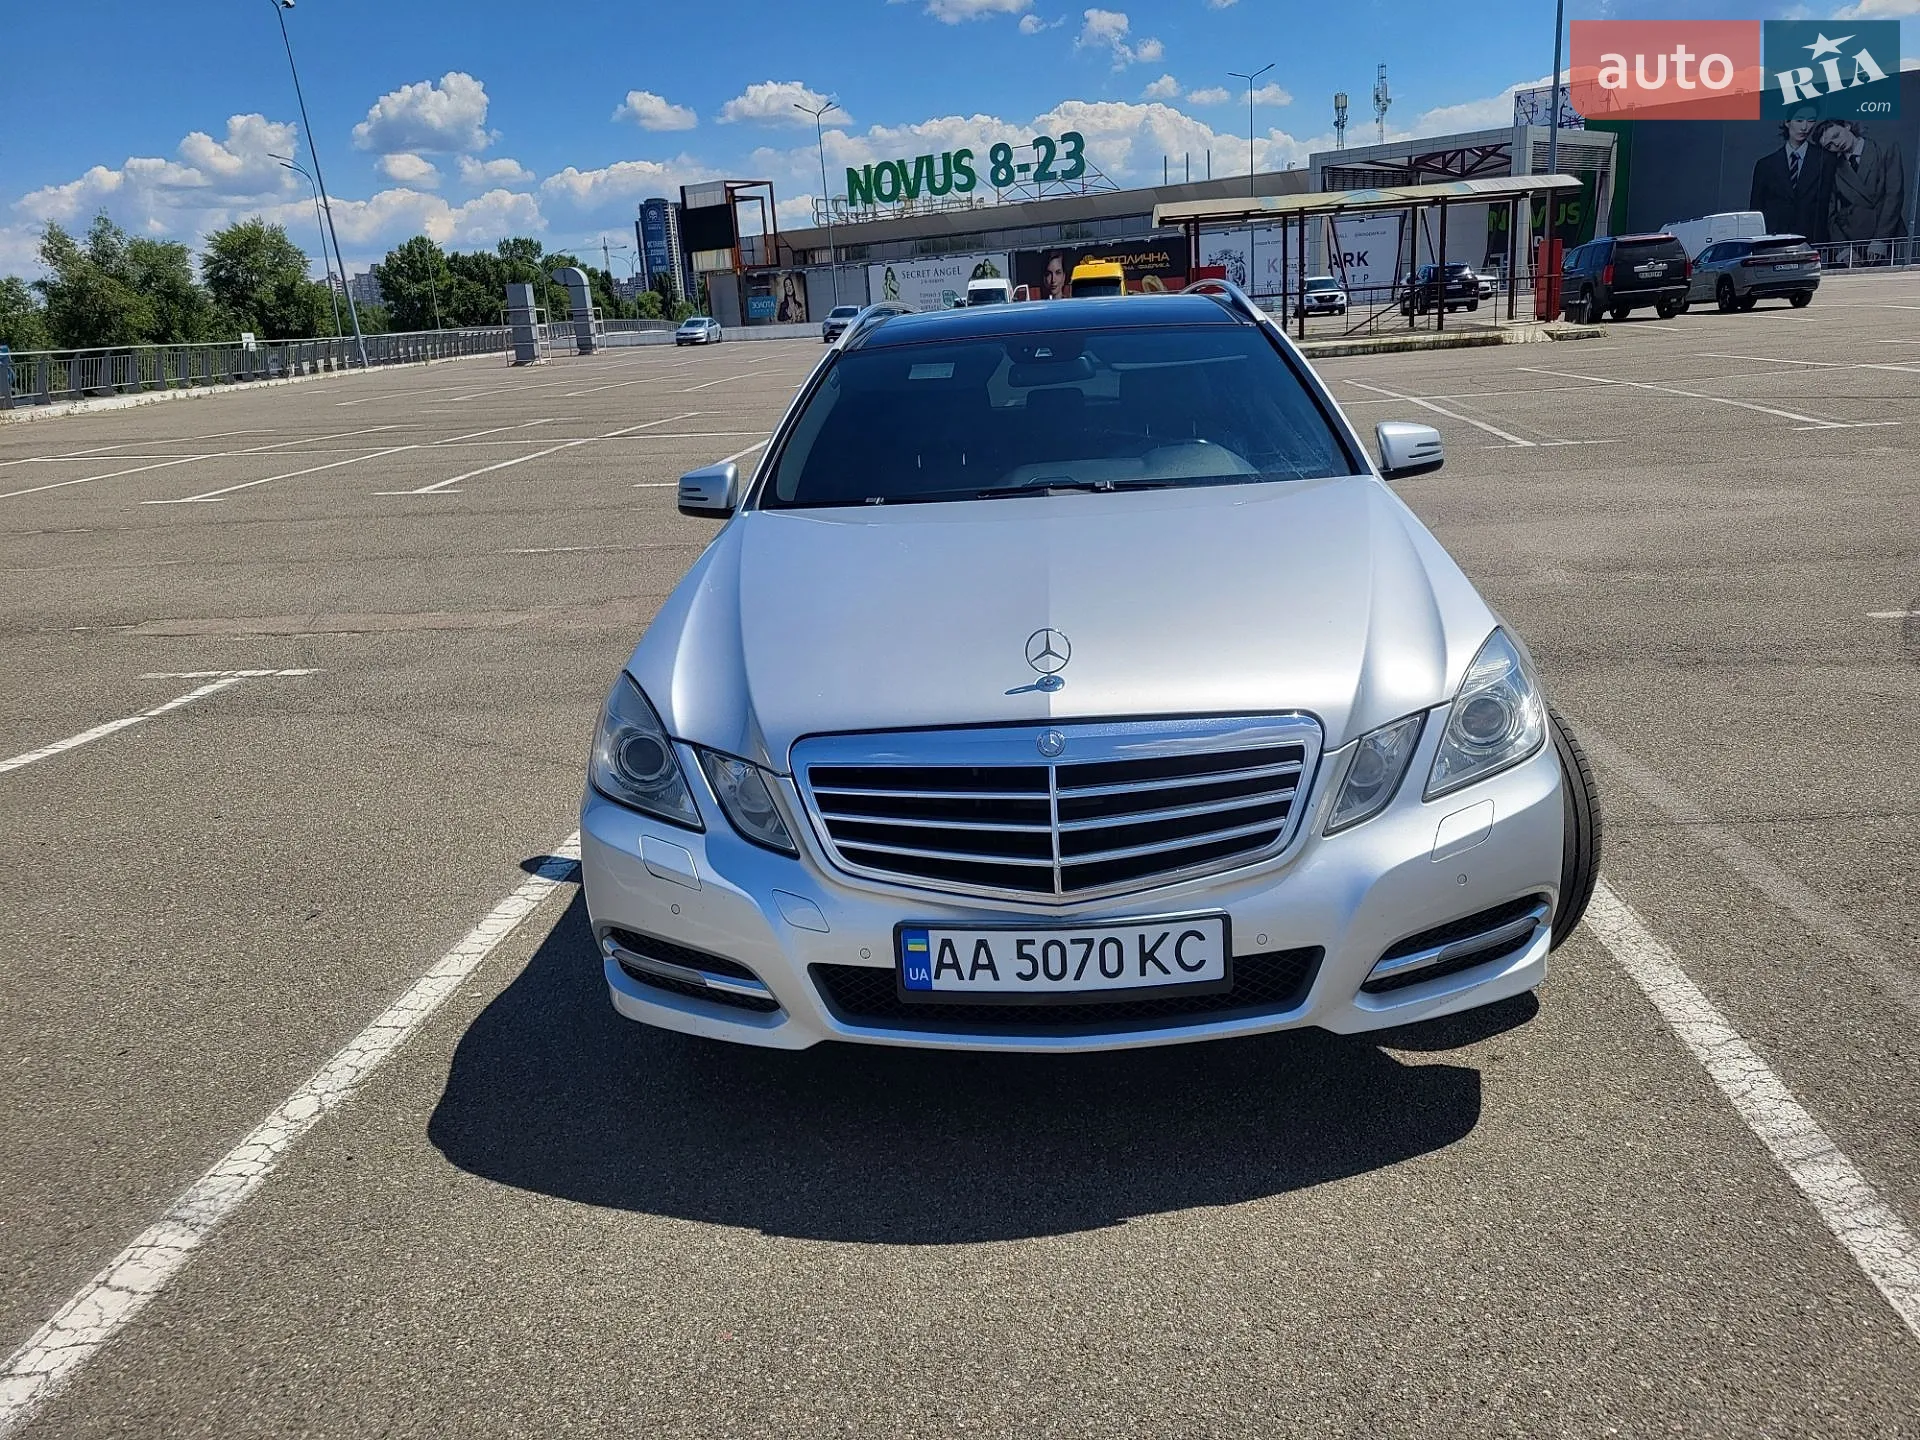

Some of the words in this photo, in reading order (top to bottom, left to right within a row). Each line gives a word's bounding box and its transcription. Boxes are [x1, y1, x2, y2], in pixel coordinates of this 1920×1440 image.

[845, 148, 977, 207] NOVUS
[989, 130, 1086, 188] 8-23
[902, 269, 932, 279] SECRET
[933, 265, 963, 277] ANGEL
[934, 938, 1000, 981] AA
[1015, 936, 1125, 982] 5070
[1138, 929, 1207, 977] KC
[909, 968, 930, 981] UA
